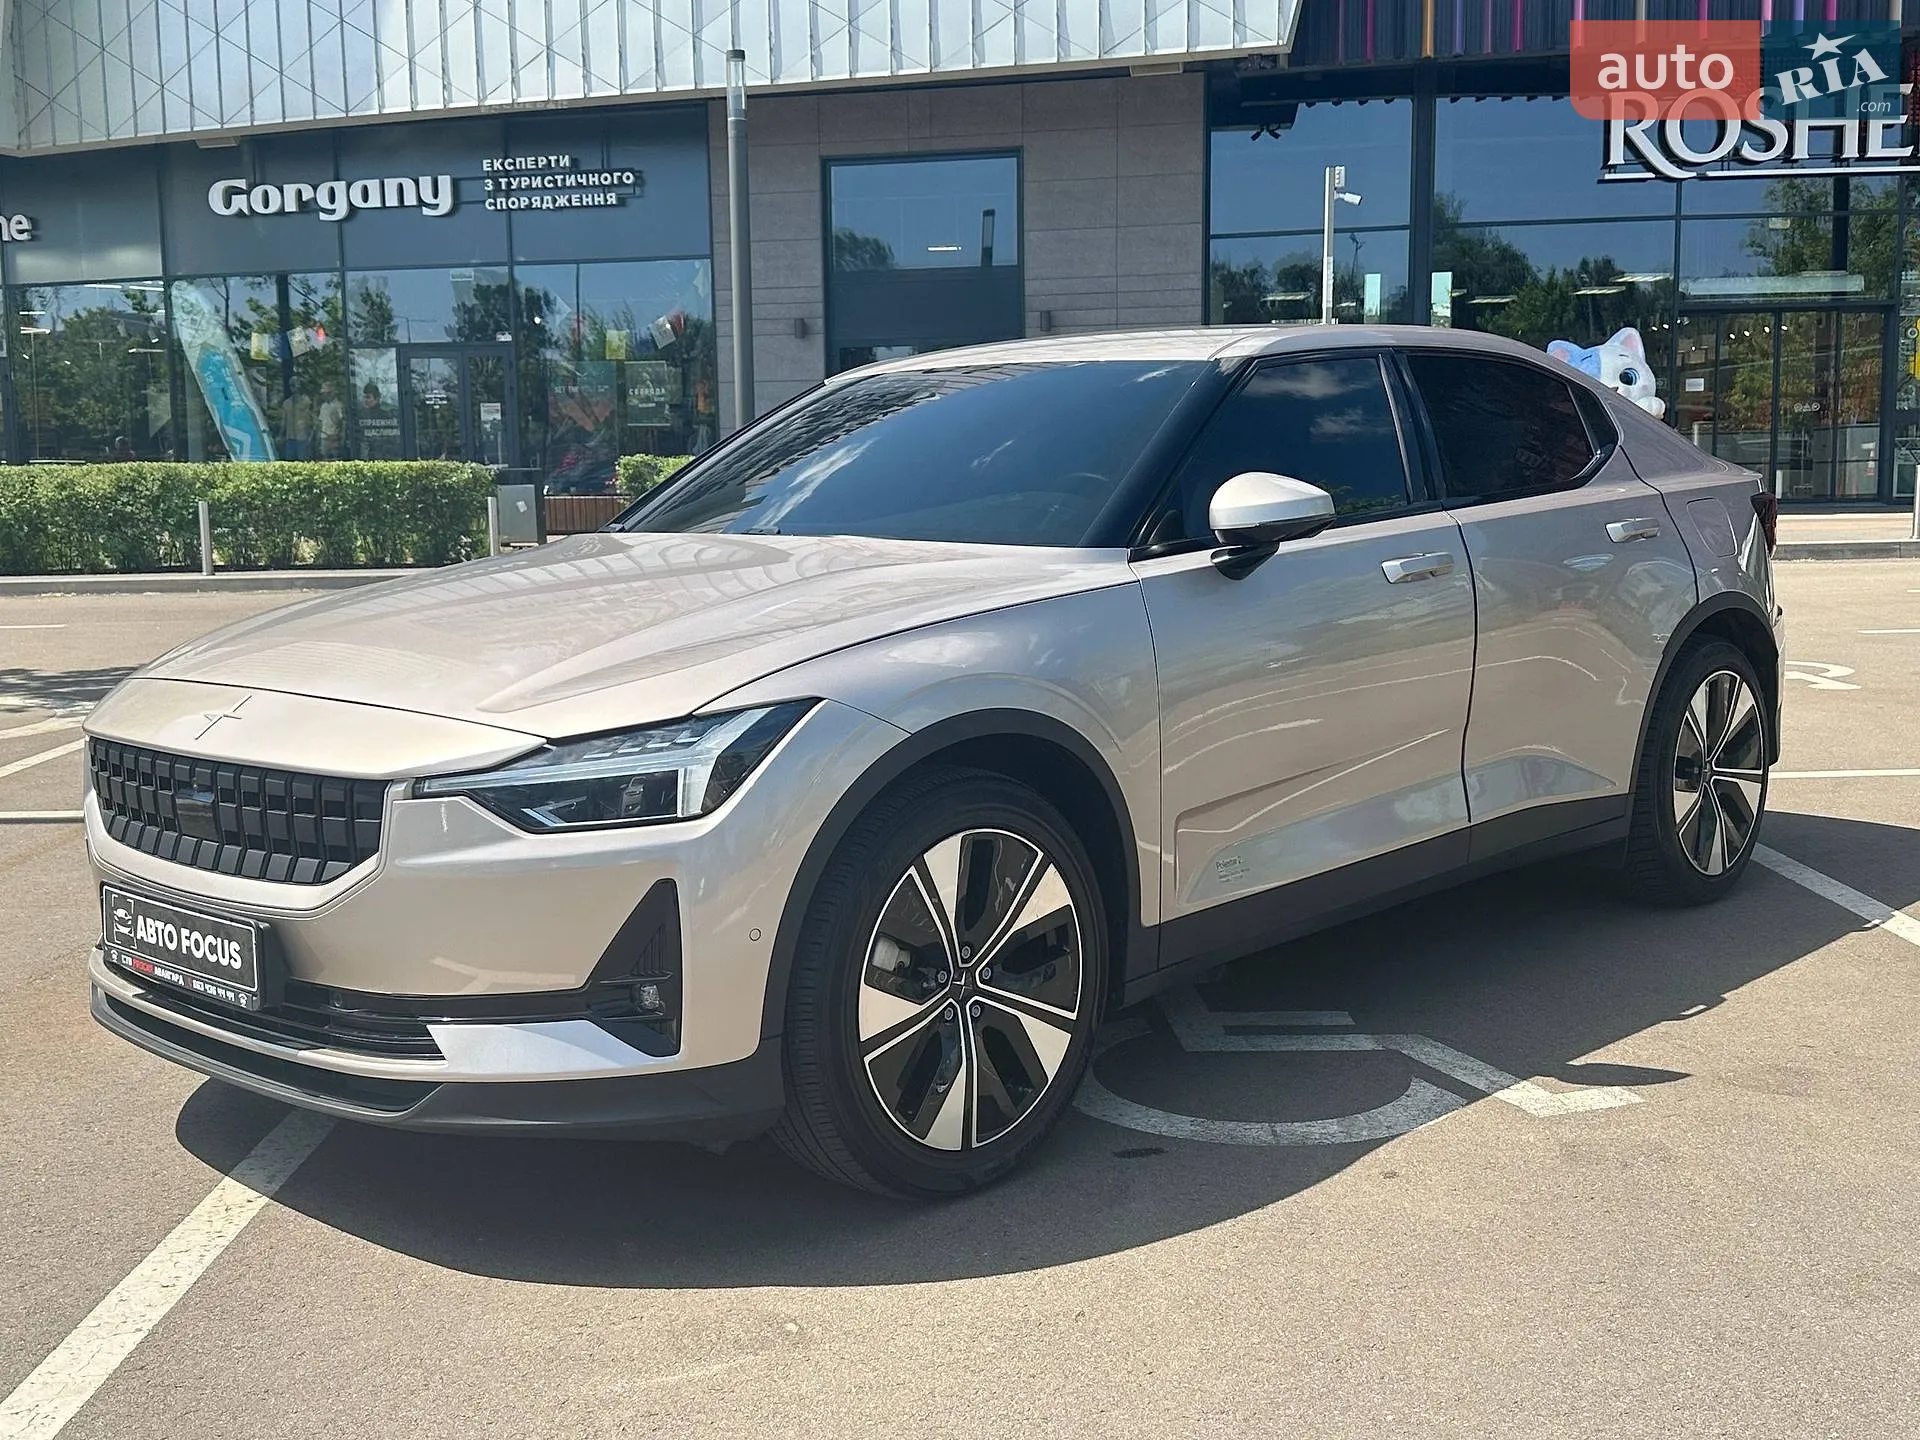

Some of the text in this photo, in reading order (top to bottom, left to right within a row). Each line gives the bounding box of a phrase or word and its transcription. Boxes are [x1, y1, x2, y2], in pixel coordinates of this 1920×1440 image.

[1608, 83, 1920, 178] ROSHE
[482, 155, 570, 171] ЕКСПЕРТИ
[499, 171, 635, 190] ТУРИСТИЧНОГО
[208, 175, 453, 221] Gorgany
[485, 192, 617, 210] СПОРЯДЖЕННЯ
[136, 914, 243, 970] АВТО FOCUS
